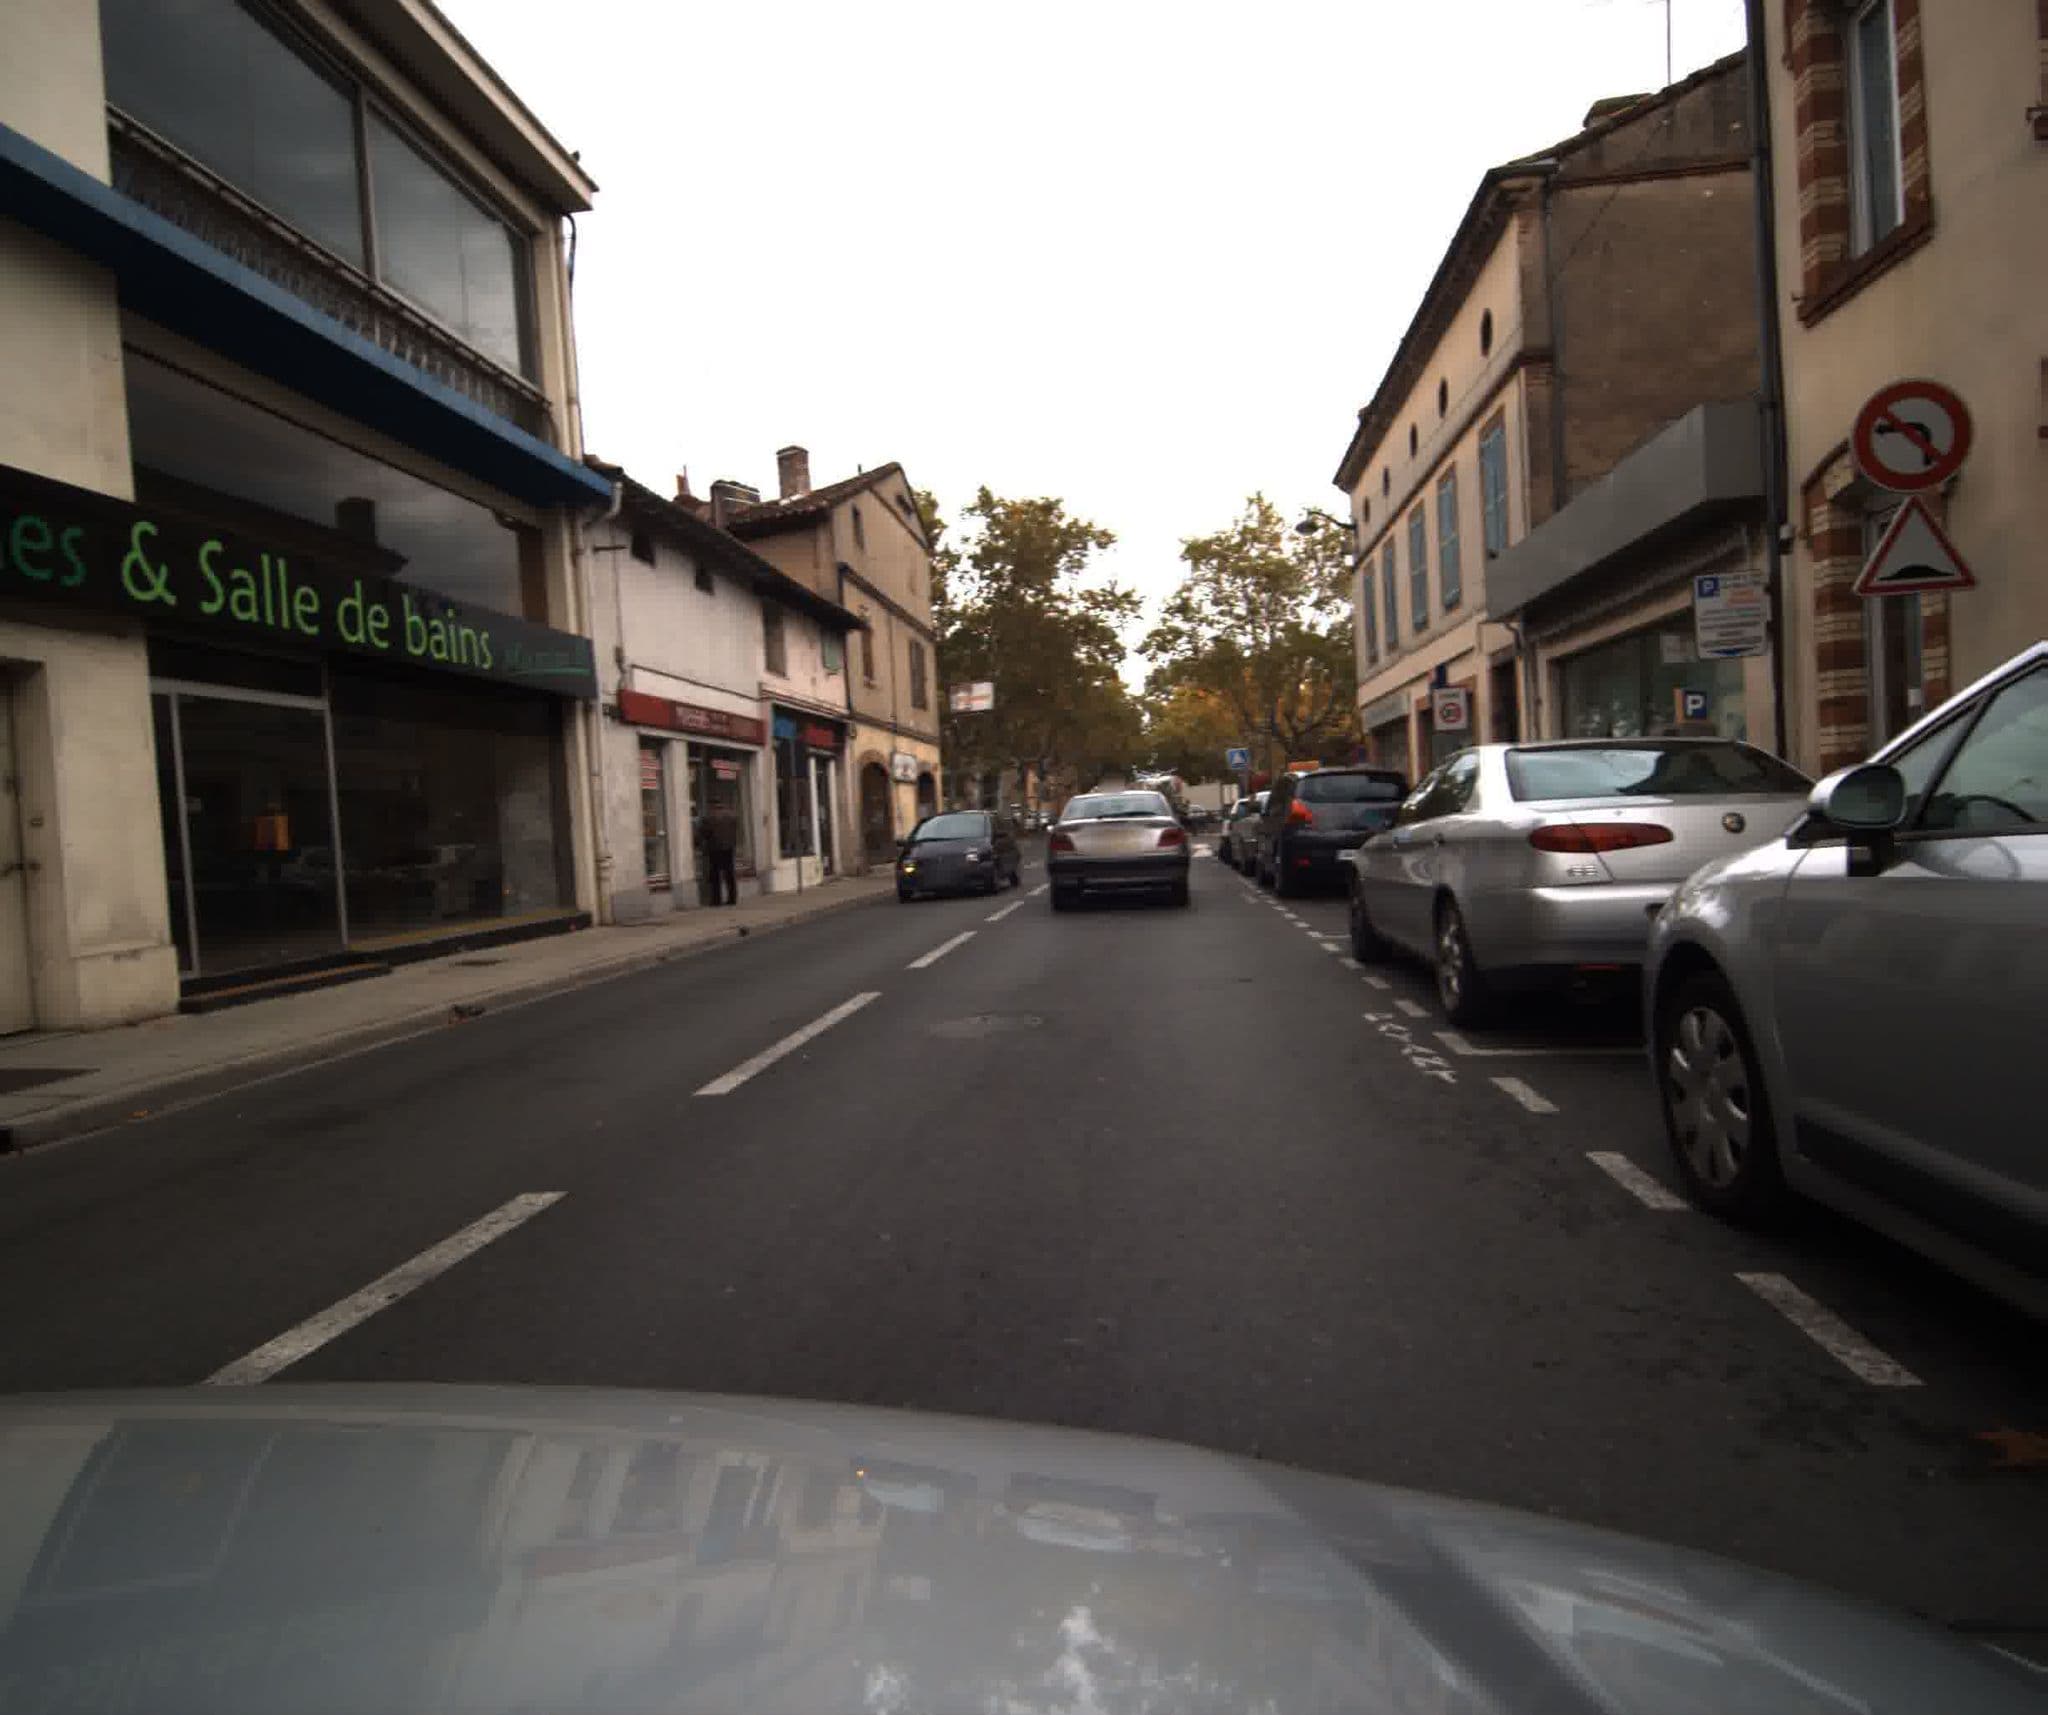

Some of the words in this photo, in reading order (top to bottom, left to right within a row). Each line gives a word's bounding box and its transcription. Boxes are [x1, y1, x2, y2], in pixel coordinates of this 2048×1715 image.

[0, 514, 87, 587] es
[121, 520, 177, 606] &
[199, 540, 320, 635] Salle
[338, 579, 391, 649] de
[402, 593, 493, 670] bains
[1686, 694, 1705, 717] P
